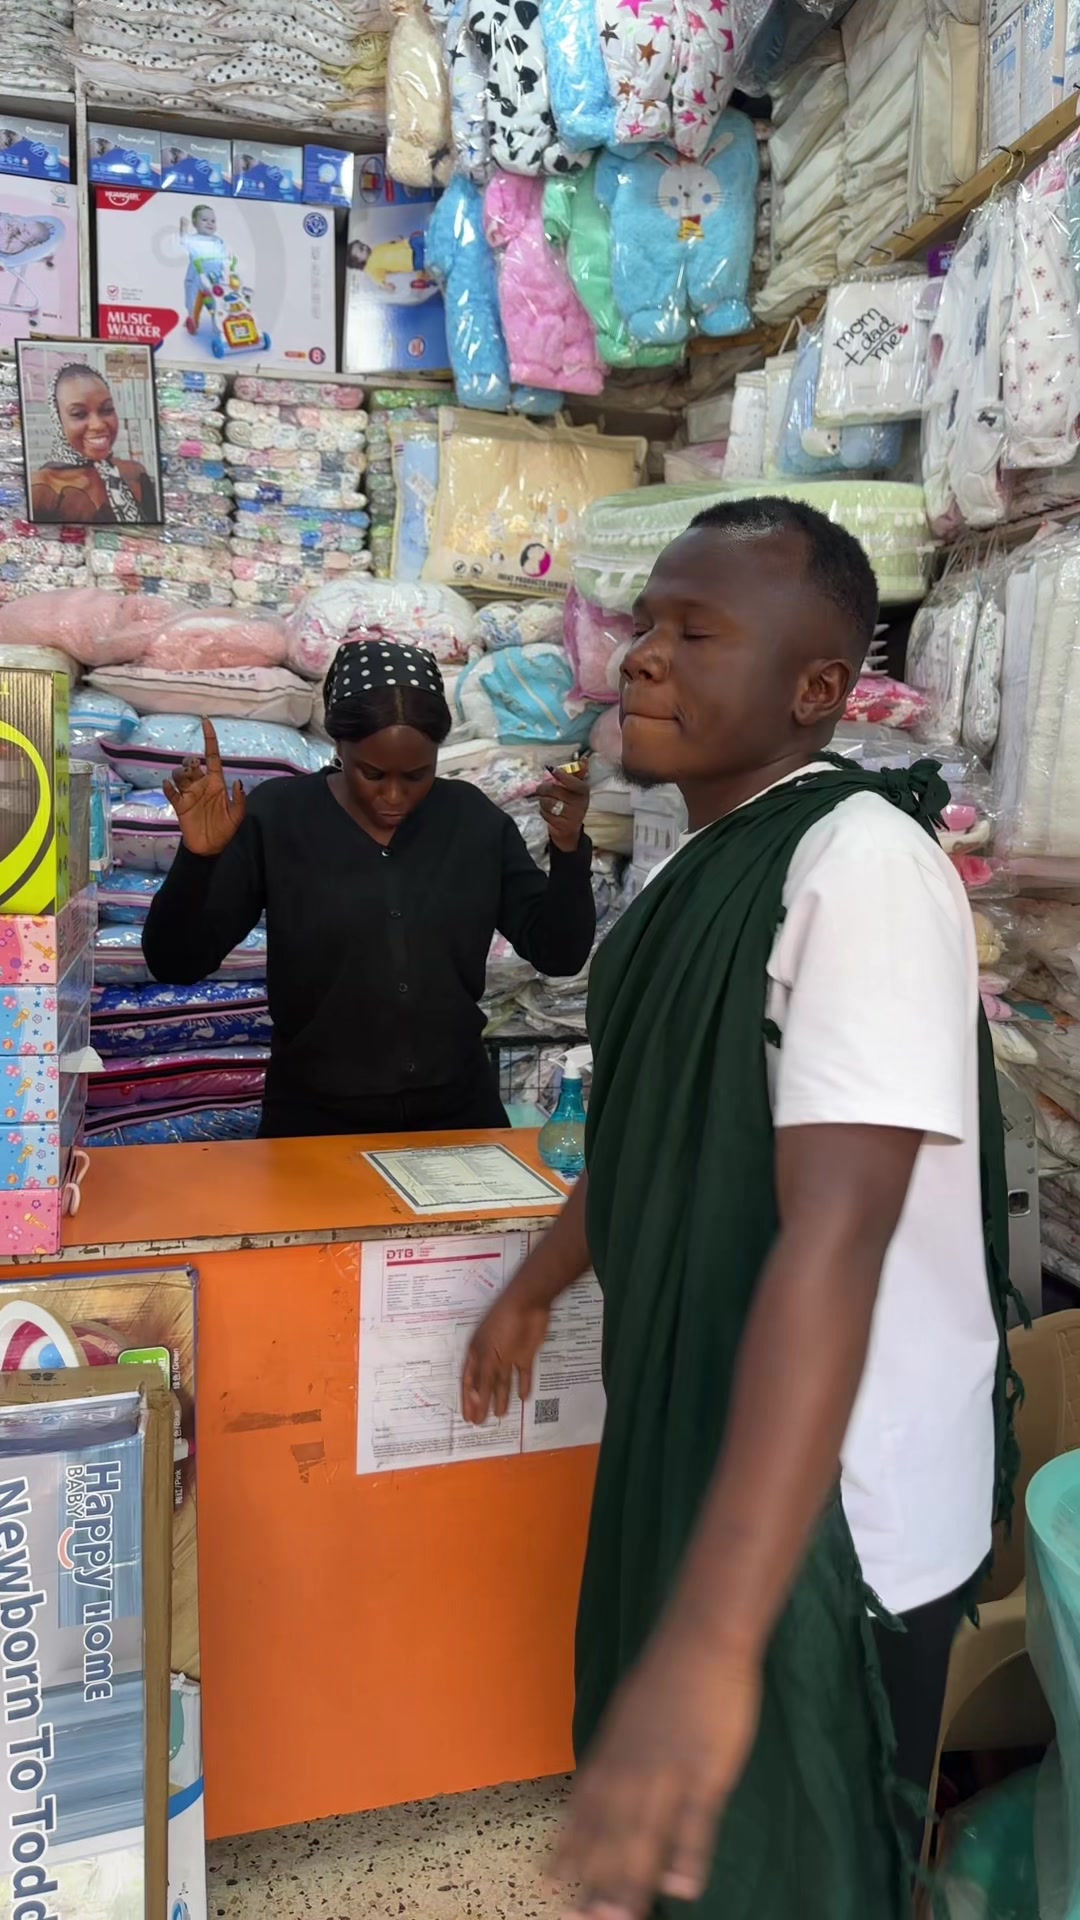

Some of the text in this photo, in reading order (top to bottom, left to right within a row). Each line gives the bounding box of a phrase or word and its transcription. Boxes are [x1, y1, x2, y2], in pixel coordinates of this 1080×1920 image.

[106, 322, 161, 338] WALKER
[107, 311, 153, 326] MUSIC
[870, 333, 903, 361] me
[386, 1248, 414, 1259] DTB
[66, 1465, 85, 1518] BABY
[0, 1476, 47, 1724] Newborn
[73, 1461, 121, 1702] Happy HOME
[7, 1722, 54, 1793] To
